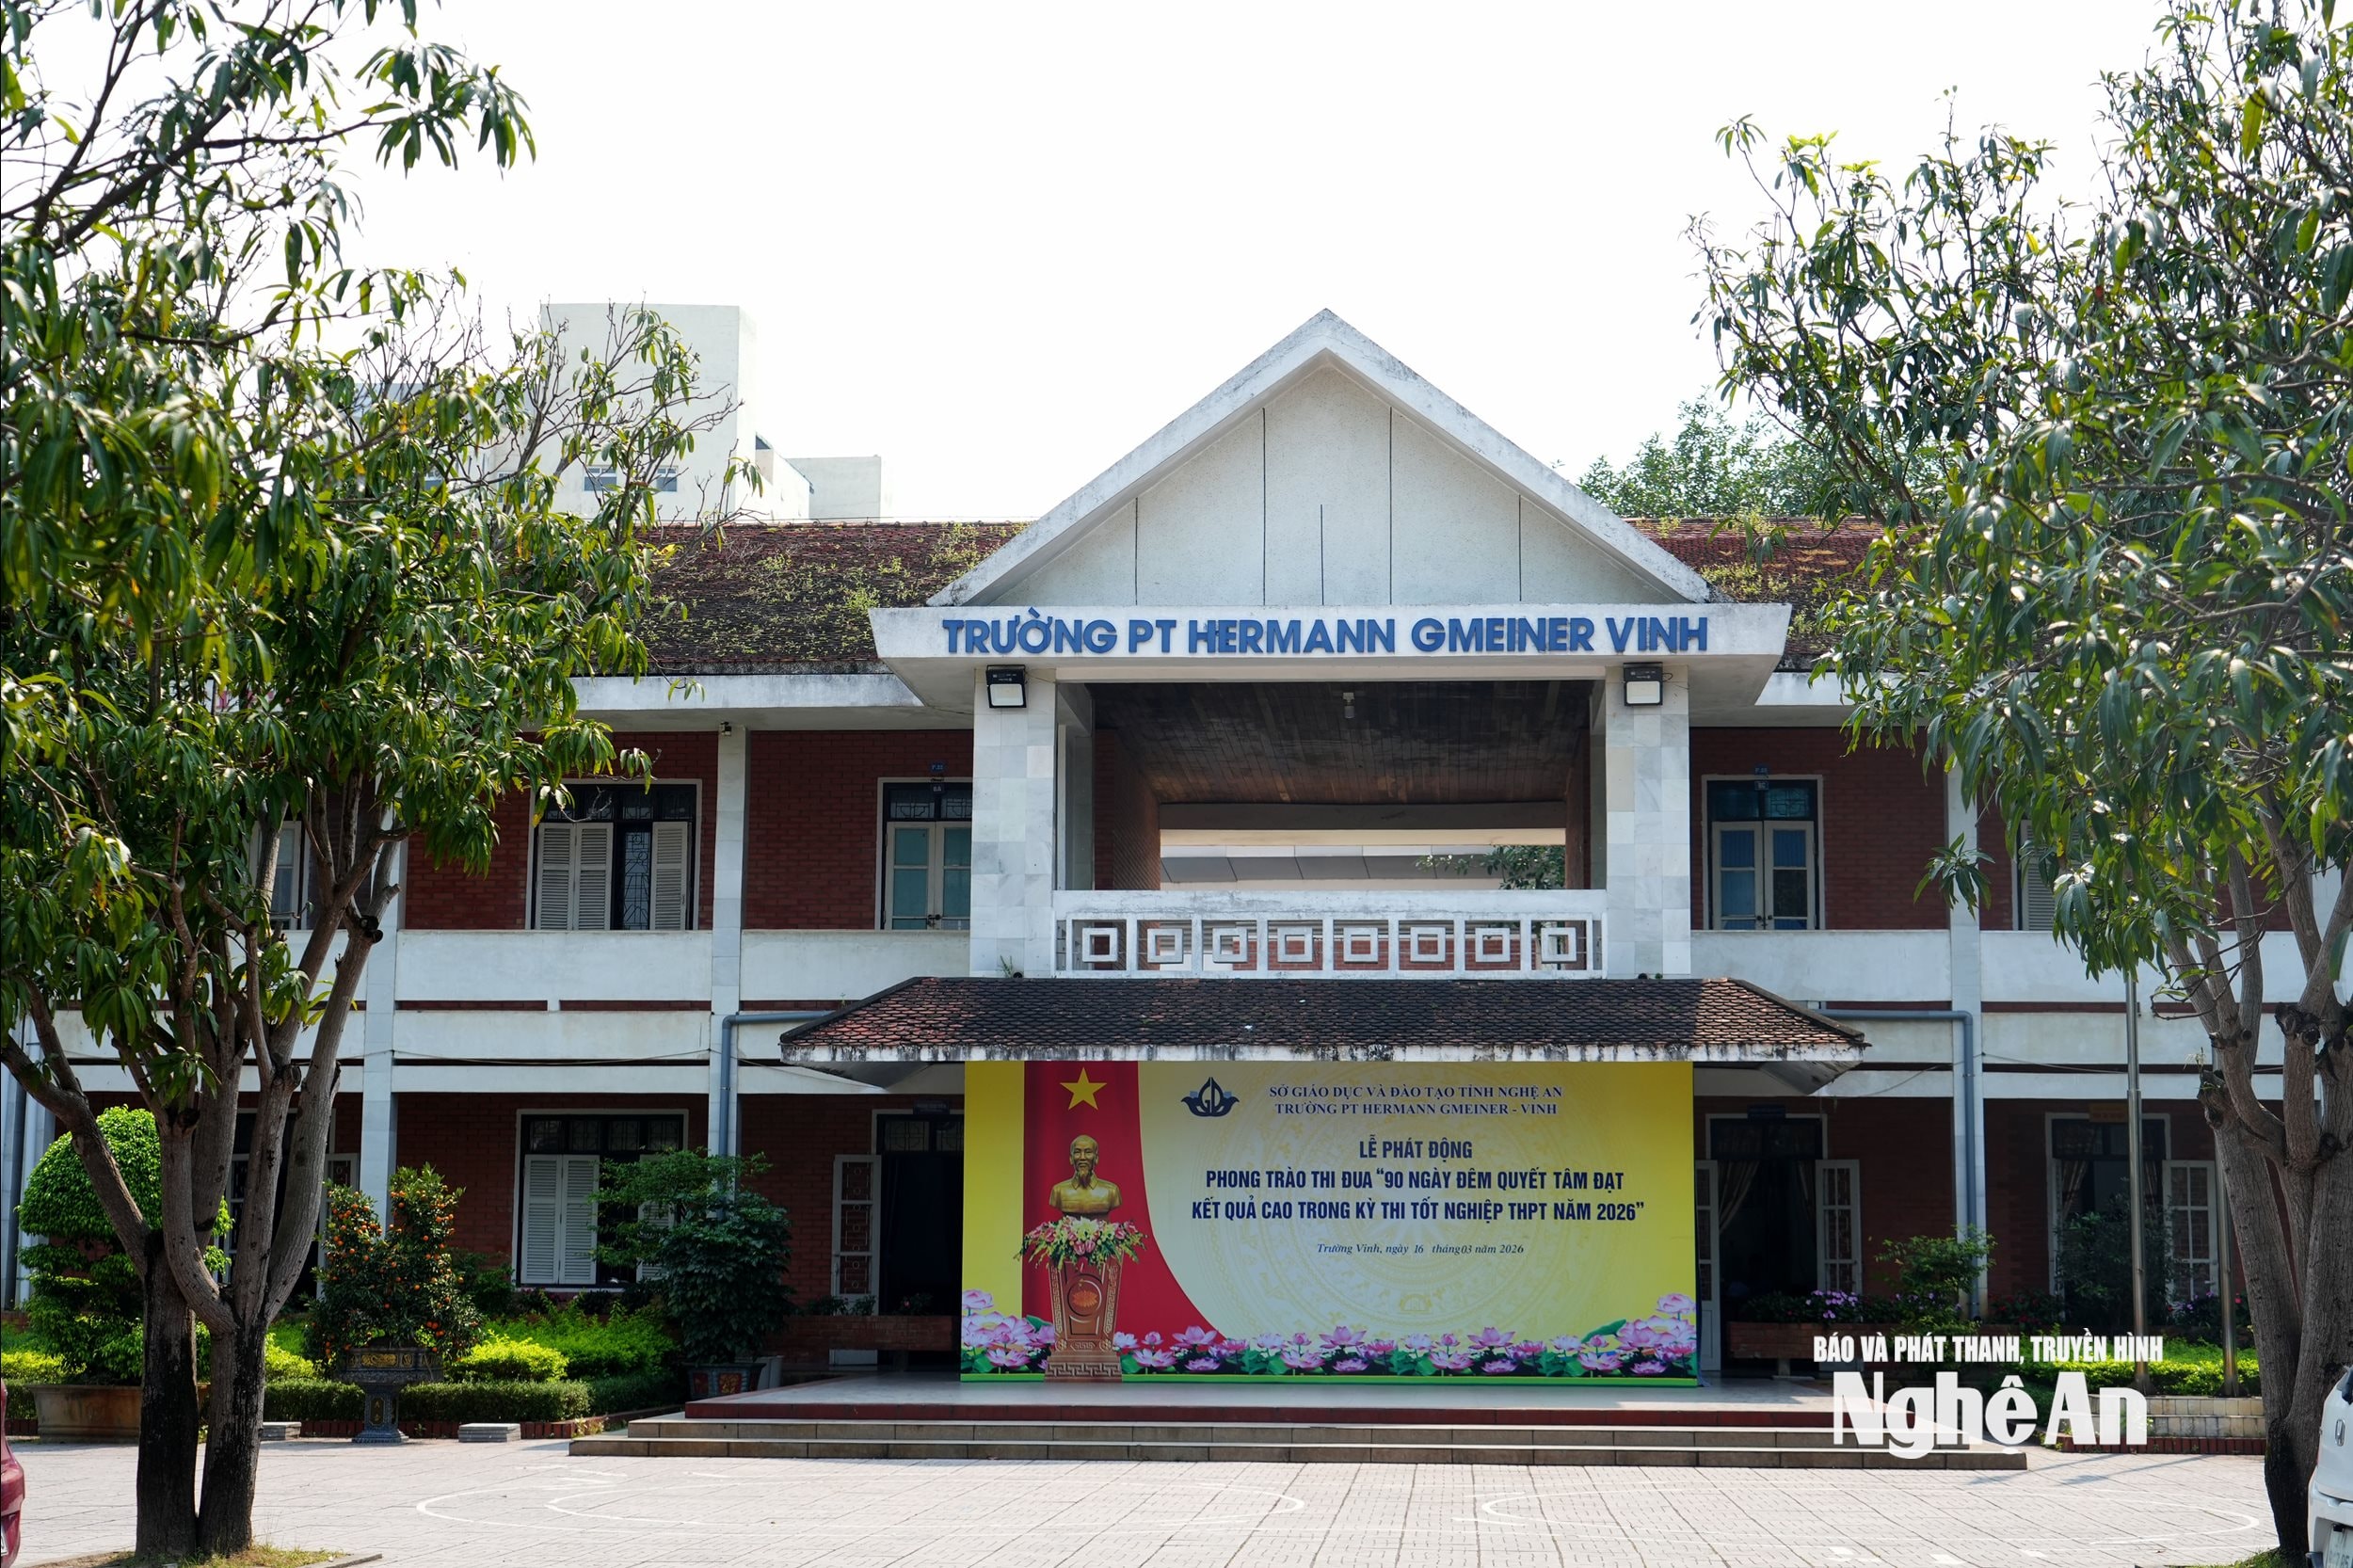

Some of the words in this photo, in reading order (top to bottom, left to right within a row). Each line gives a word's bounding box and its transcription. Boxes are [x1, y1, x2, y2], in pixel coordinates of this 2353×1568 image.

[942, 606, 1117, 653] TRƯỜNG
[1129, 619, 1176, 653] PT
[1189, 618, 1395, 653] HERMANN
[1412, 617, 1596, 652] GMEINER
[1606, 617, 1707, 652] VINH
[1270, 1084, 1289, 1097] SỞ
[1292, 1083, 1329, 1097] GIÁO
[1333, 1086, 1363, 1100] DỤC
[1367, 1083, 1387, 1097] VÀ
[1390, 1083, 1421, 1097] ĐÀO
[1425, 1086, 1455, 1100] TẠO
[1459, 1083, 1494, 1097] TỈNH
[1498, 1083, 1539, 1099] NGHỆ
[1543, 1087, 1563, 1097] AN
[1274, 1100, 1337, 1114] TRƯỜNG
[1341, 1104, 1359, 1114] PT
[1363, 1104, 1436, 1114] HERMANN
[1440, 1104, 1509, 1114] GMEINER
[1521, 1104, 1558, 1114] VINH
[1359, 1134, 1377, 1159] LỄ
[1383, 1137, 1423, 1159] PHÁT
[1429, 1137, 1473, 1162] ĐỘNG
[1206, 1171, 1260, 1188] PHONG
[1266, 1166, 1306, 1188] TRÀO
[1311, 1171, 1336, 1188] THI
[1341, 1171, 1372, 1189] ĐUA
[1409, 1167, 1451, 1189] NGÀY
[1456, 1168, 1492, 1189] ĐÊM
[1497, 1167, 1546, 1191] QUYẾT
[1553, 1168, 1588, 1190] TÂM
[1593, 1173, 1625, 1193] ĐẠT
[1192, 1196, 1221, 1219] KẾT
[1225, 1195, 1257, 1221] QUẢ
[1261, 1201, 1292, 1219] CAO
[1298, 1201, 1350, 1219] TRONG
[1355, 1197, 1376, 1219] KỲ
[1381, 1202, 1405, 1219] THI
[1411, 1196, 1439, 1220] TỐT
[1445, 1199, 1503, 1224] NGHIỆP
[1508, 1203, 1547, 1221] THPT
[1553, 1199, 1591, 1221] NĂM
[1317, 1243, 1353, 1254] Trường
[1356, 1243, 1382, 1254] Vinh,
[1385, 1244, 1409, 1254] ngày
[1414, 1244, 1424, 1254] 16
[1475, 1244, 1497, 1254] năm
[1499, 1244, 1524, 1254] 2026
